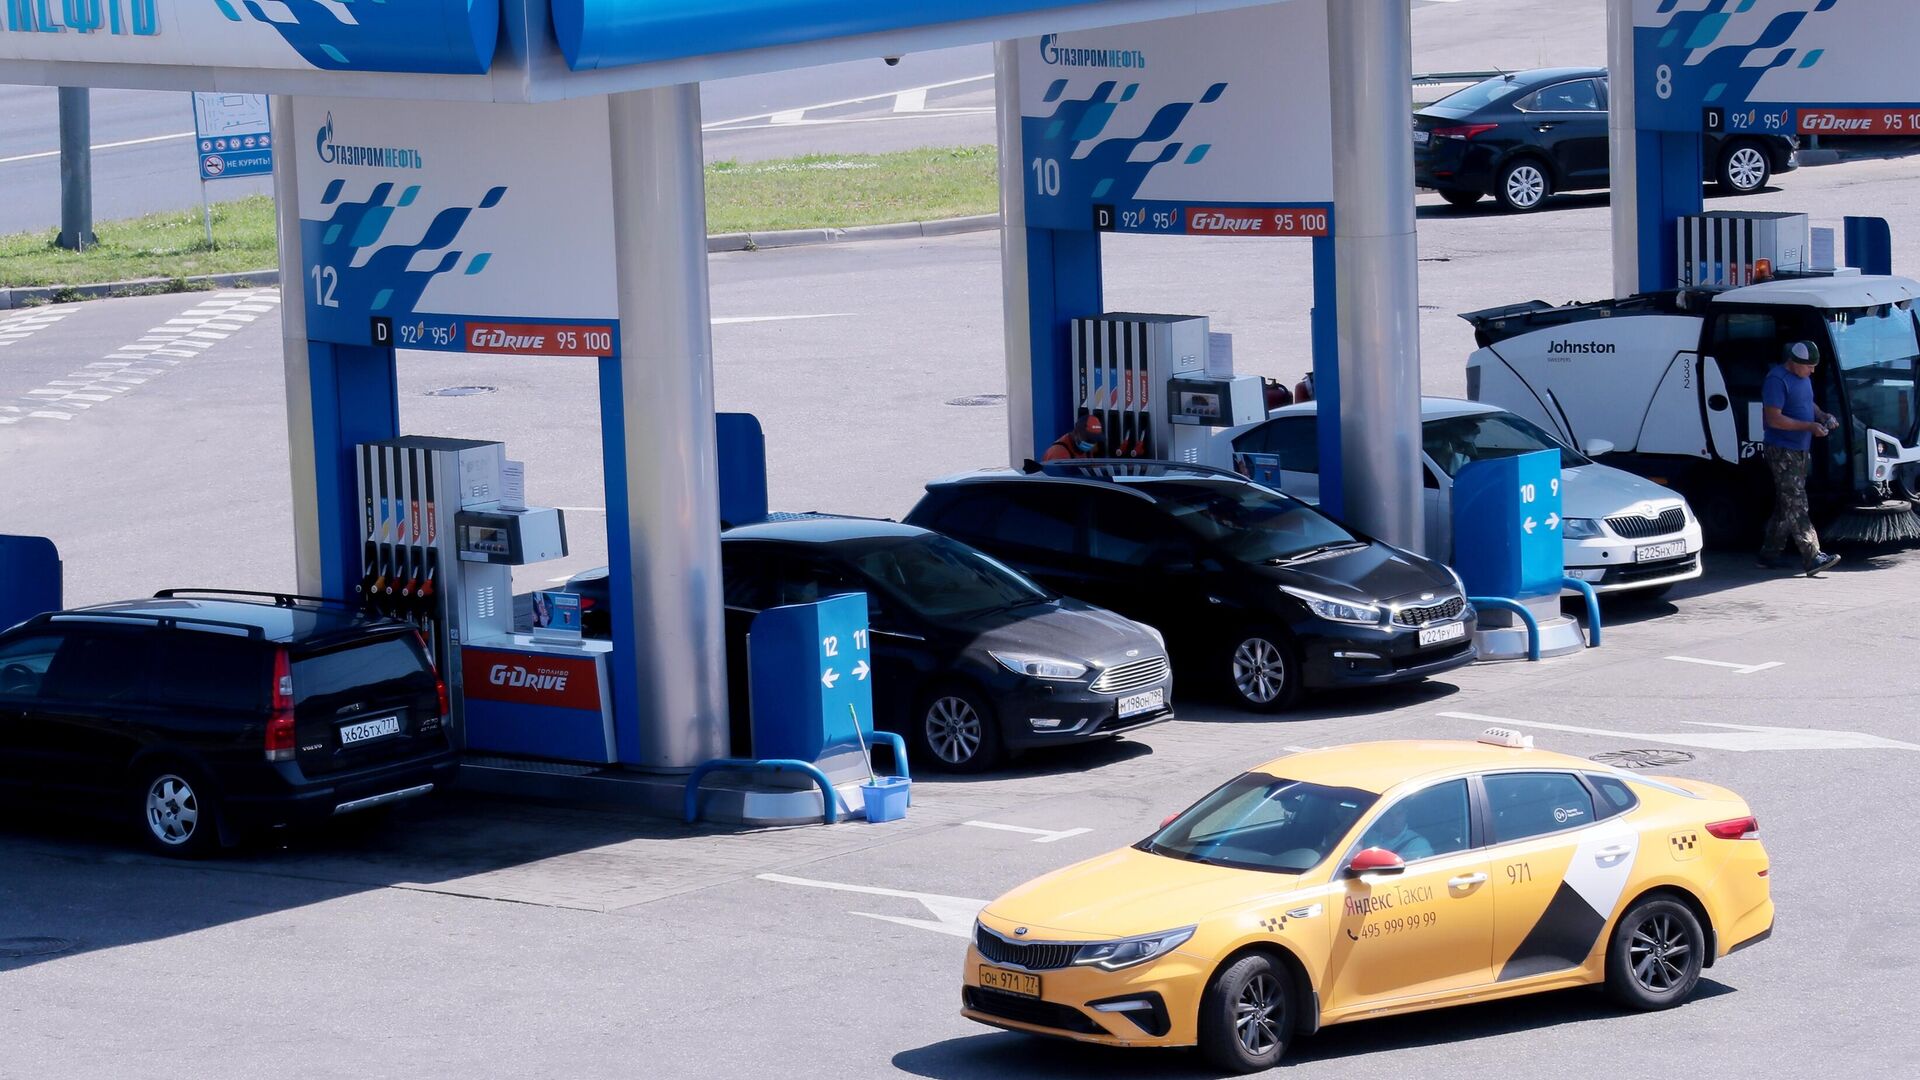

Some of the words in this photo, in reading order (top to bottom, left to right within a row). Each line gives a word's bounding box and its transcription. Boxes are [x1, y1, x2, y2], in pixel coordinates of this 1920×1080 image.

[1059, 48, 1145, 69] ГАЗПРОМНЕФТЬ
[1655, 64, 1672, 99] 8
[1709, 112, 1718, 128] D
[1732, 113, 1748, 129] 92
[1763, 113, 1780, 129] 95
[1883, 114, 1902, 129] 95
[226, 160, 238, 168] НЕ
[238, 157, 271, 167] КУРИТЬ!
[336, 144, 422, 169] ГАЗПРОМНЕФТЬ
[1032, 157, 1060, 197] 10
[1099, 209, 1109, 227] D
[1122, 211, 1138, 228] 92
[1152, 212, 1170, 229] 95
[1274, 214, 1294, 230] 95
[1299, 214, 1326, 231] 100
[311, 264, 339, 308] 12
[377, 322, 387, 341] D
[401, 324, 417, 343] 92
[432, 327, 448, 345] 95
[557, 331, 577, 350] 95
[583, 332, 610, 351] 100
[1547, 339, 1616, 354] Johnston
[1520, 483, 1535, 503] 10
[1550, 478, 1559, 497] 9
[823, 635, 838, 657] 12
[853, 629, 867, 650] 11
[381, 717, 396, 730] 777
[1506, 861, 1532, 885] 971
[1345, 893, 1393, 917] Яндекс
[1394, 885, 1434, 906] Такси
[1361, 922, 1380, 939] 495
[1384, 918, 1404, 935] 999
[1406, 914, 1420, 930] 99
[1423, 911, 1437, 927] 99
[985, 973, 996, 985] ОН
[1001, 972, 1019, 990] 971
[1024, 976, 1035, 988] 77
